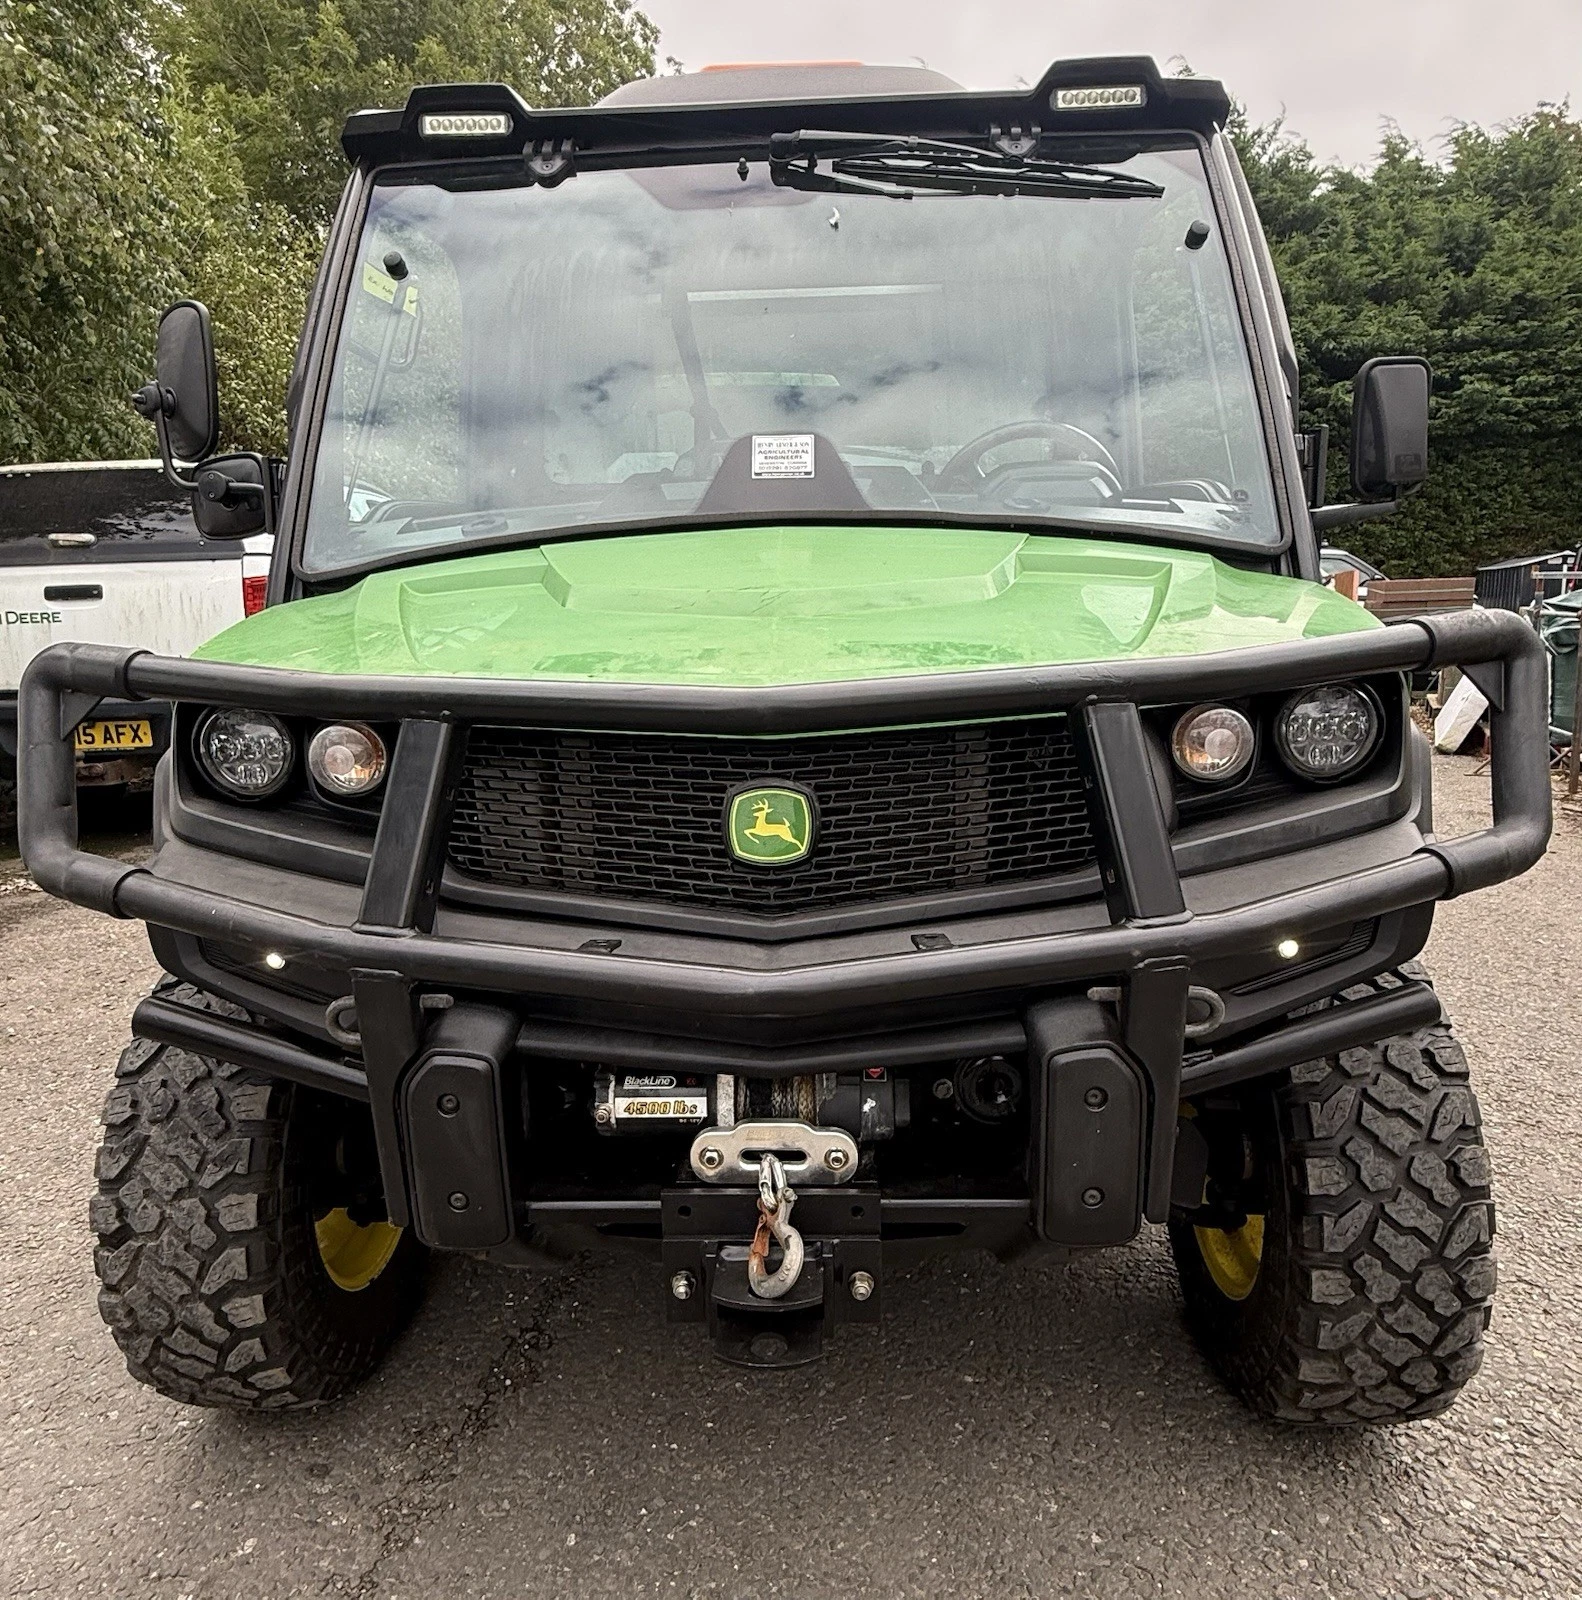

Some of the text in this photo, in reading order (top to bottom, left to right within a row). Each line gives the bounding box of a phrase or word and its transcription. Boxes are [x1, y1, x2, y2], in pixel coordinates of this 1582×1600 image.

[5, 611, 62, 625] DEERE
[103, 723, 144, 745] AFX
[624, 1076, 671, 1086] BlackLine
[623, 1100, 698, 1115] 4500 lbs
